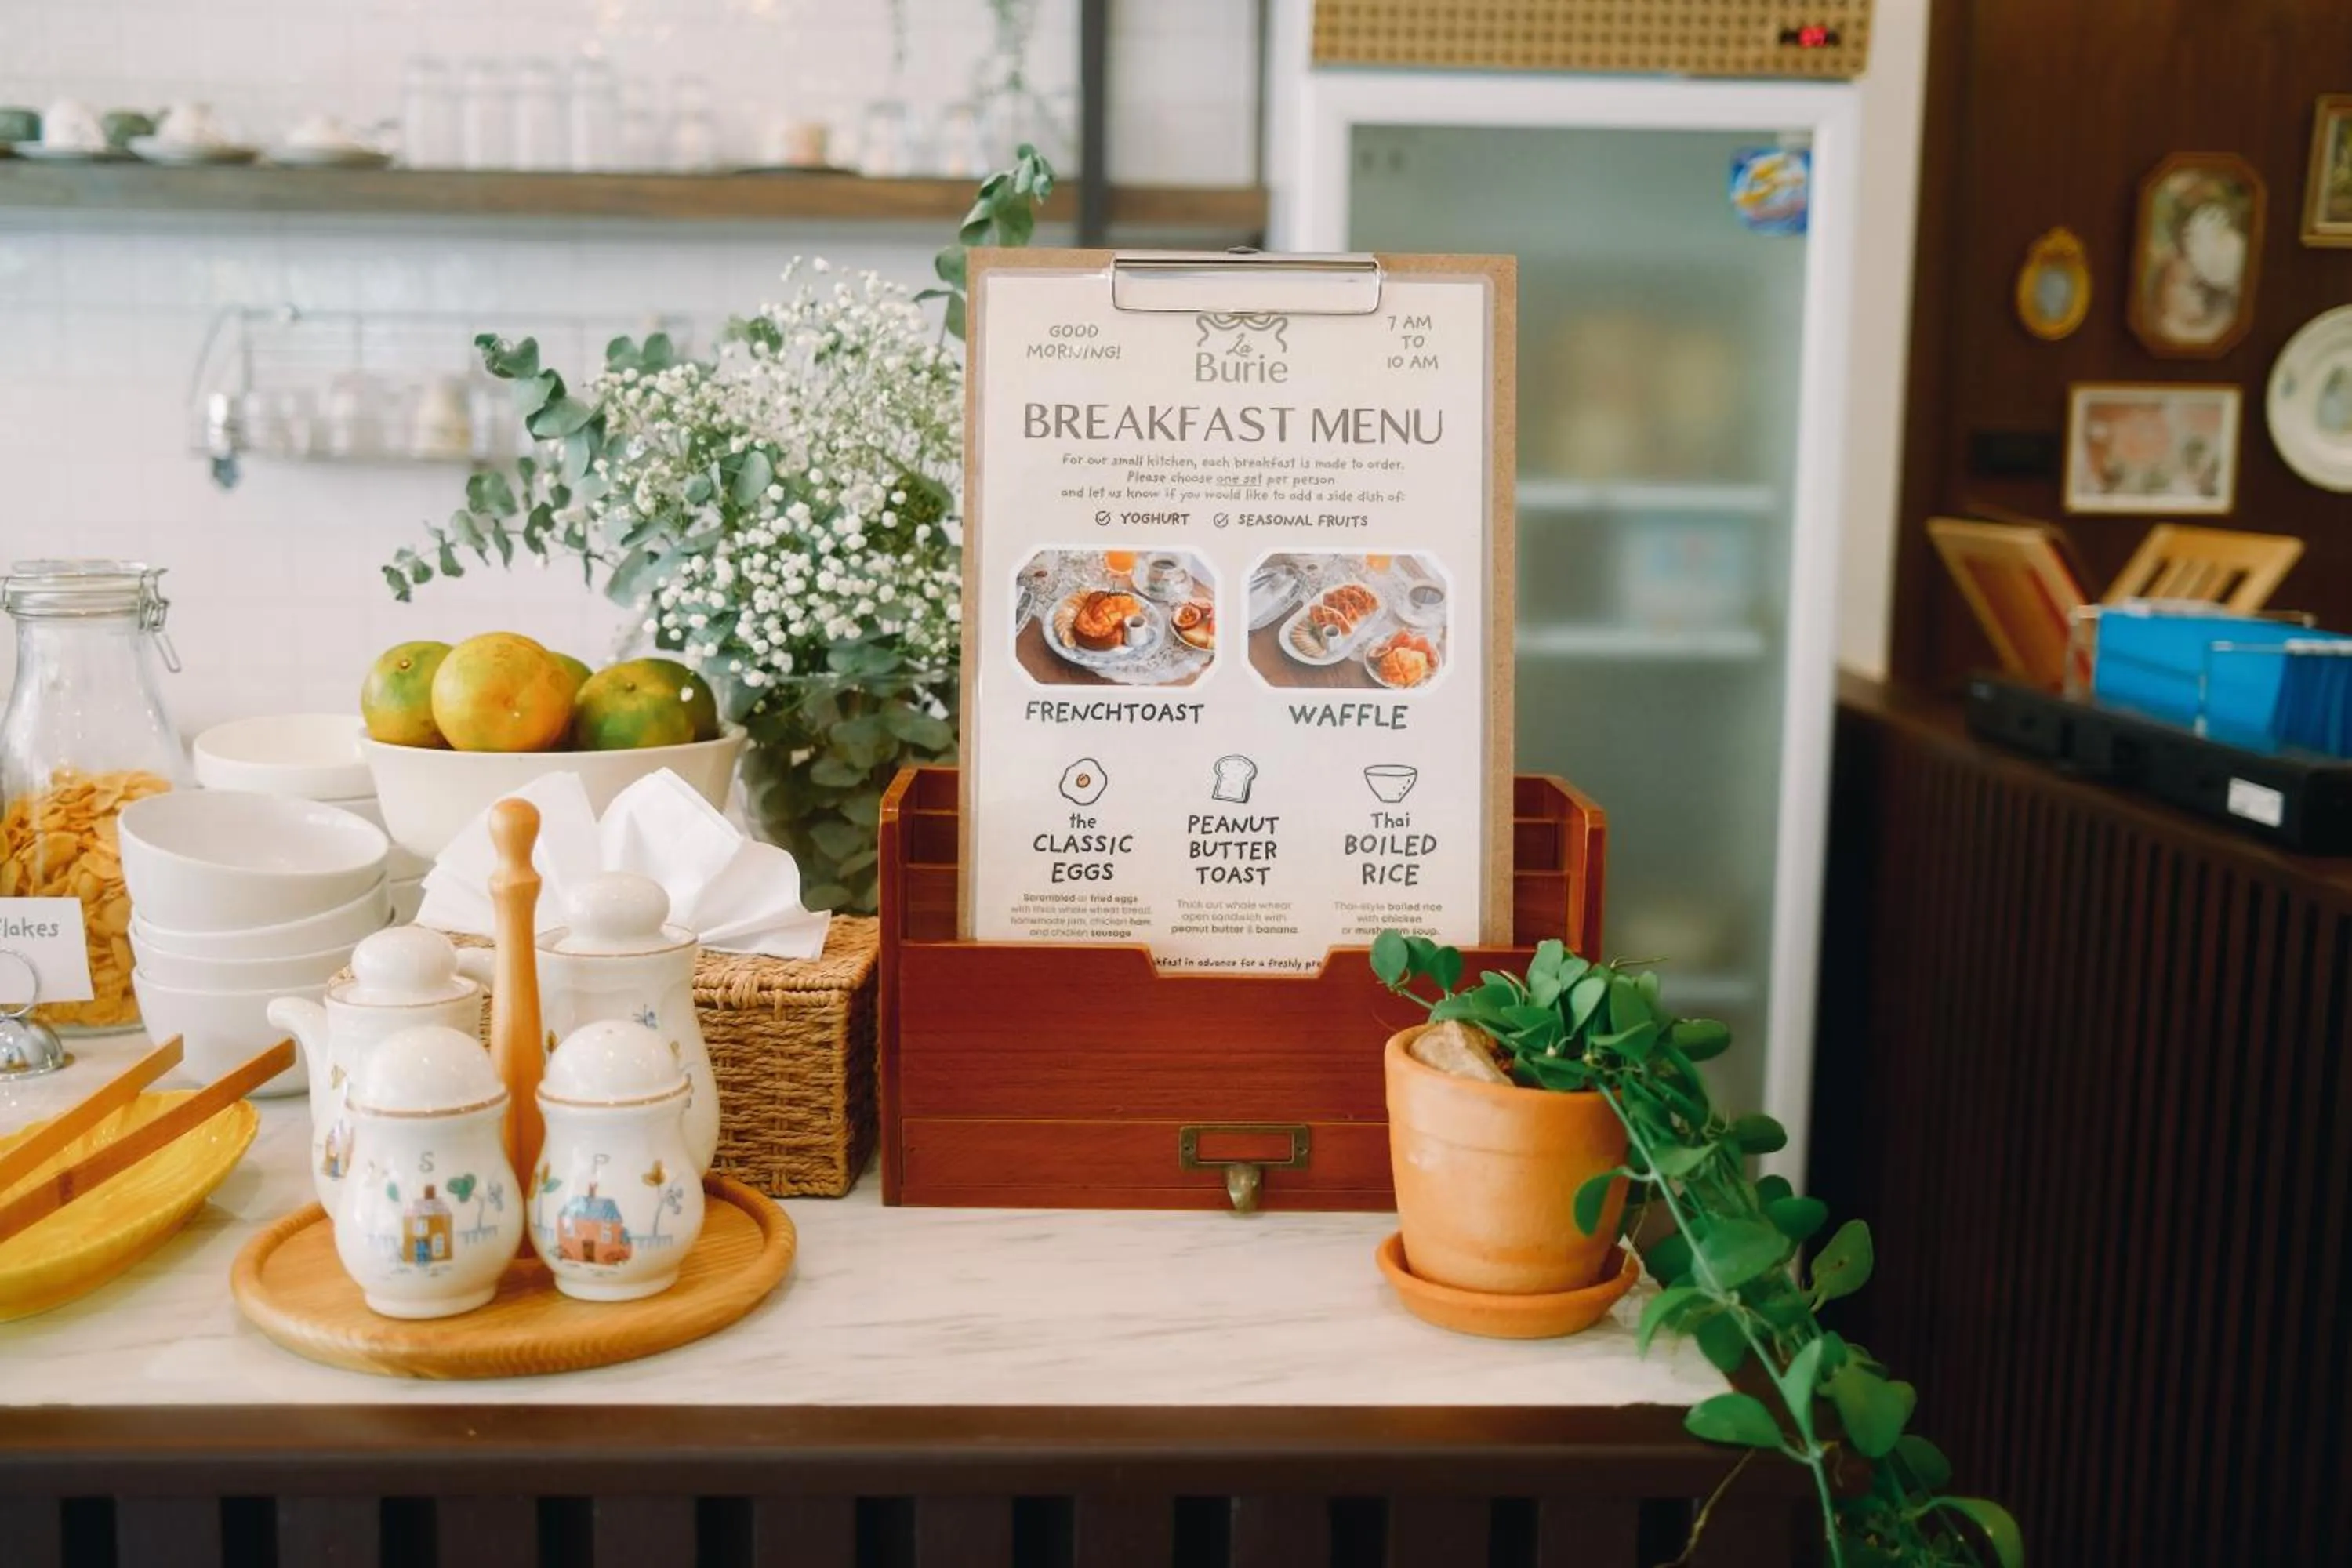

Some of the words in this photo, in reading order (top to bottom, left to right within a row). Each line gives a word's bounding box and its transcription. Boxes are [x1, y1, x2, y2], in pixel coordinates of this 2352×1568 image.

[1386, 315, 1396, 330] 7
[1403, 315, 1432, 330] AM
[1049, 324, 1098, 338] GOOD
[1401, 334, 1425, 349] TO
[1026, 343, 1121, 360] MORNING!
[1195, 352, 1288, 383] Burie
[1386, 355, 1403, 369] 10
[1410, 355, 1439, 370] AM
[1022, 403, 1295, 443] BREAKFAST
[1311, 408, 1444, 445] MENU
[1062, 453, 1083, 465] For
[1111, 455, 1142, 466] small
[1147, 455, 1197, 470] kitchen,
[1202, 456, 1230, 468] each
[1234, 456, 1294, 469] breakfast
[1301, 458, 1310, 469] is
[1315, 458, 1346, 469] made
[1352, 458, 1363, 469] to
[1367, 458, 1405, 470] order.
[1127, 470, 1166, 483] Please
[1171, 474, 1213, 484] choose
[1216, 476, 1239, 485] one
[1243, 474, 1262, 485] set
[1266, 476, 1287, 488] per
[1293, 476, 1335, 488] person
[1061, 486, 1083, 498] and
[1088, 486, 1105, 497] let
[1127, 486, 1160, 498] know
[1164, 487, 1177, 499] if
[1180, 491, 1201, 503] you
[1205, 488, 1240, 500] would
[1246, 489, 1268, 501] like
[1273, 490, 1284, 500] to
[1290, 490, 1312, 501] add
[1327, 491, 1352, 502] side
[1357, 491, 1384, 503] dish
[1120, 512, 1190, 525] YOGHURT
[1237, 514, 1313, 528] SEASONAL
[1317, 514, 1369, 528] FRUITS
[1025, 700, 1205, 724] FRENCHTOAST
[1287, 703, 1409, 730] WAFFLE
[1069, 813, 1098, 829] the
[1187, 815, 1280, 836] PEANUT
[1370, 812, 1411, 829] Thai
[1033, 833, 1134, 855] CLASSIC
[1189, 840, 1279, 861] BUTTER
[1344, 835, 1438, 856] BOILED
[1051, 862, 1115, 884] EGGS
[1195, 866, 1272, 886] TOAST
[1361, 863, 1421, 887] RICE
[1114, 896, 1138, 905] eggs
[1178, 900, 1203, 910] Thick
[1225, 901, 1256, 910] whole
[1258, 902, 1292, 911] wheat
[1387, 902, 1421, 912] boiled
[1422, 903, 1443, 912] rice
[1058, 905, 1087, 914] whole
[1089, 905, 1120, 914] wheat
[1011, 916, 1065, 925] homemade
[1089, 916, 1127, 926] chicken
[1181, 913, 1210, 924] open
[1211, 913, 1262, 922] sandwich
[1264, 913, 1287, 922] with
[1356, 914, 1380, 924] with
[1381, 914, 1423, 924] chicken
[1029, 928, 1049, 937] and
[1051, 928, 1089, 937] chicken
[1091, 929, 1131, 938] sausage
[1171, 925, 1209, 935] peanut
[1211, 924, 1245, 934] butter
[1354, 927, 1410, 935] mushm
[1184, 957, 1194, 967] in
[1198, 957, 1236, 967] advance
[1240, 957, 1255, 967] for
[1268, 958, 1301, 970] freshly
[419, 1151, 434, 1173] S
[593, 1153, 611, 1174] P
